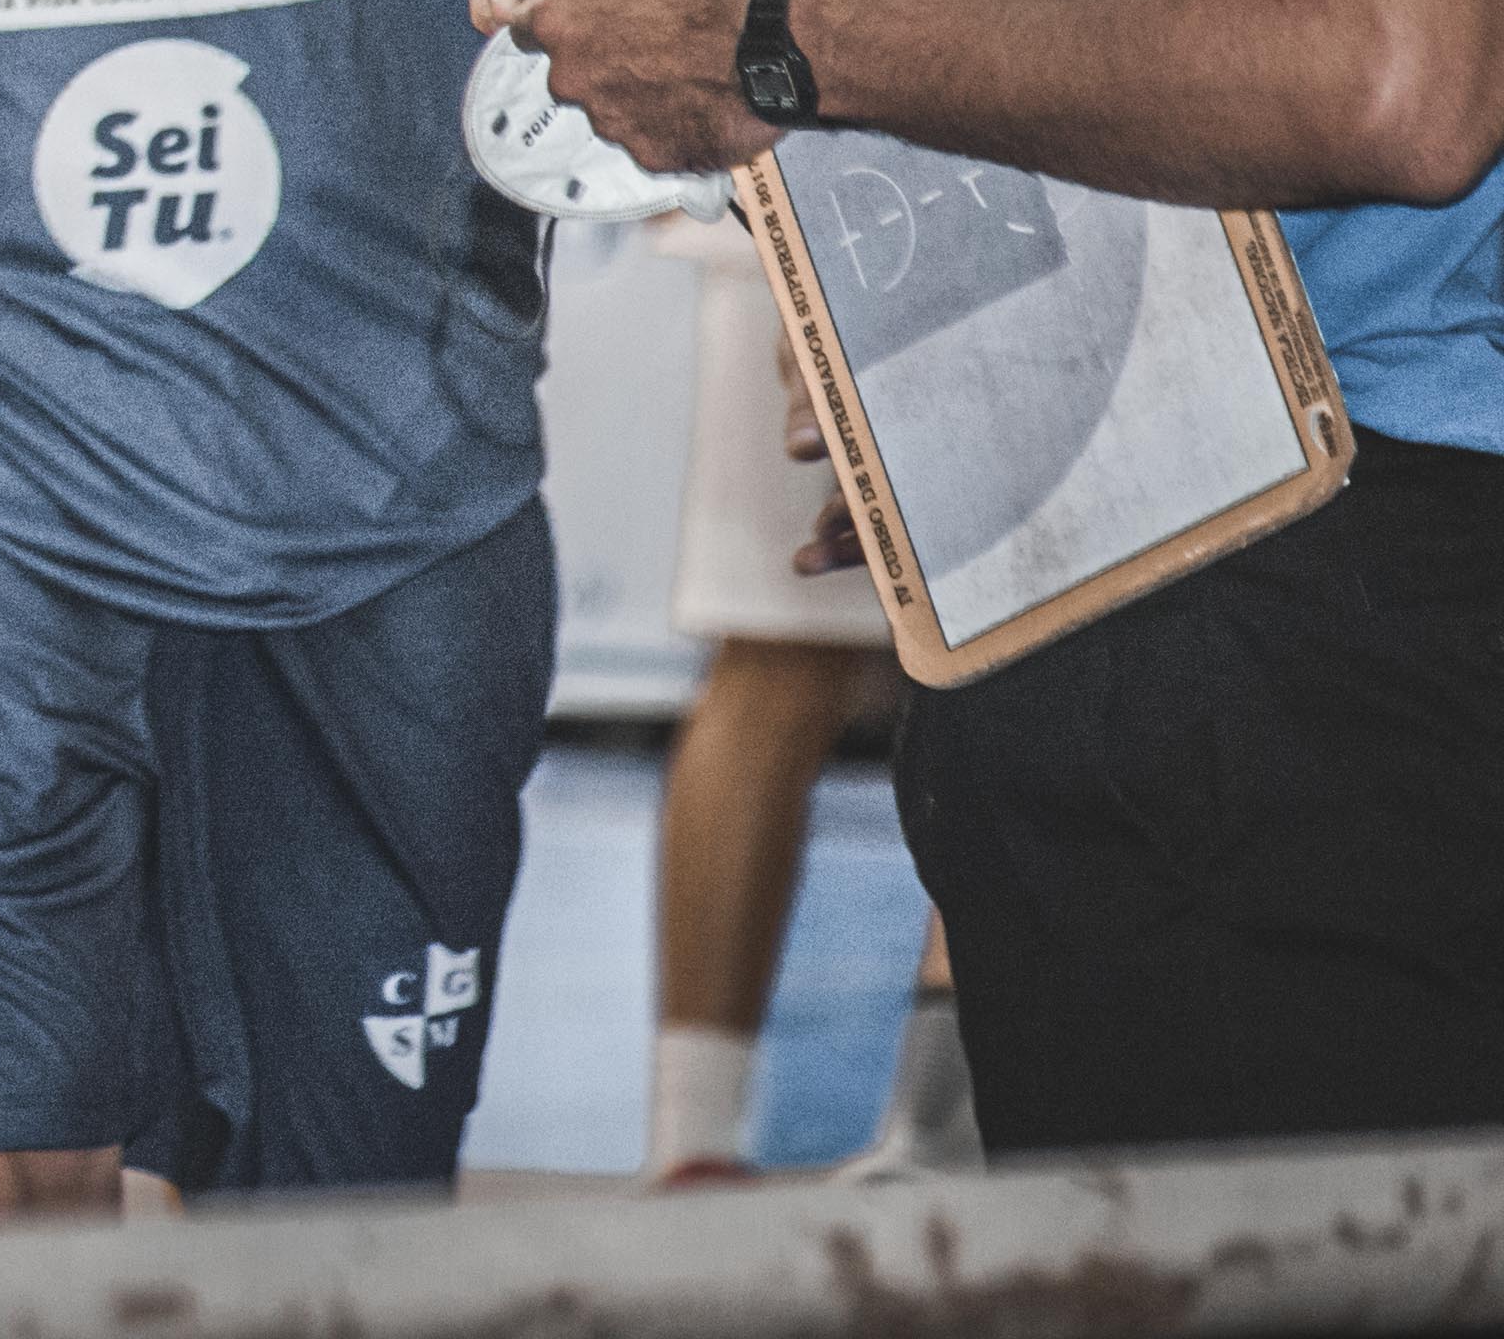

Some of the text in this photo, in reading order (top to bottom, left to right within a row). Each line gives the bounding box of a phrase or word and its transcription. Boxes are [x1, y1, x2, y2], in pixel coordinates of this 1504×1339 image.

[90, 102, 220, 179] Sei
[764, 210, 812, 319] SUPERIOR
[804, 321, 865, 469] ENTRENADOR
[855, 472, 878, 504] DE
